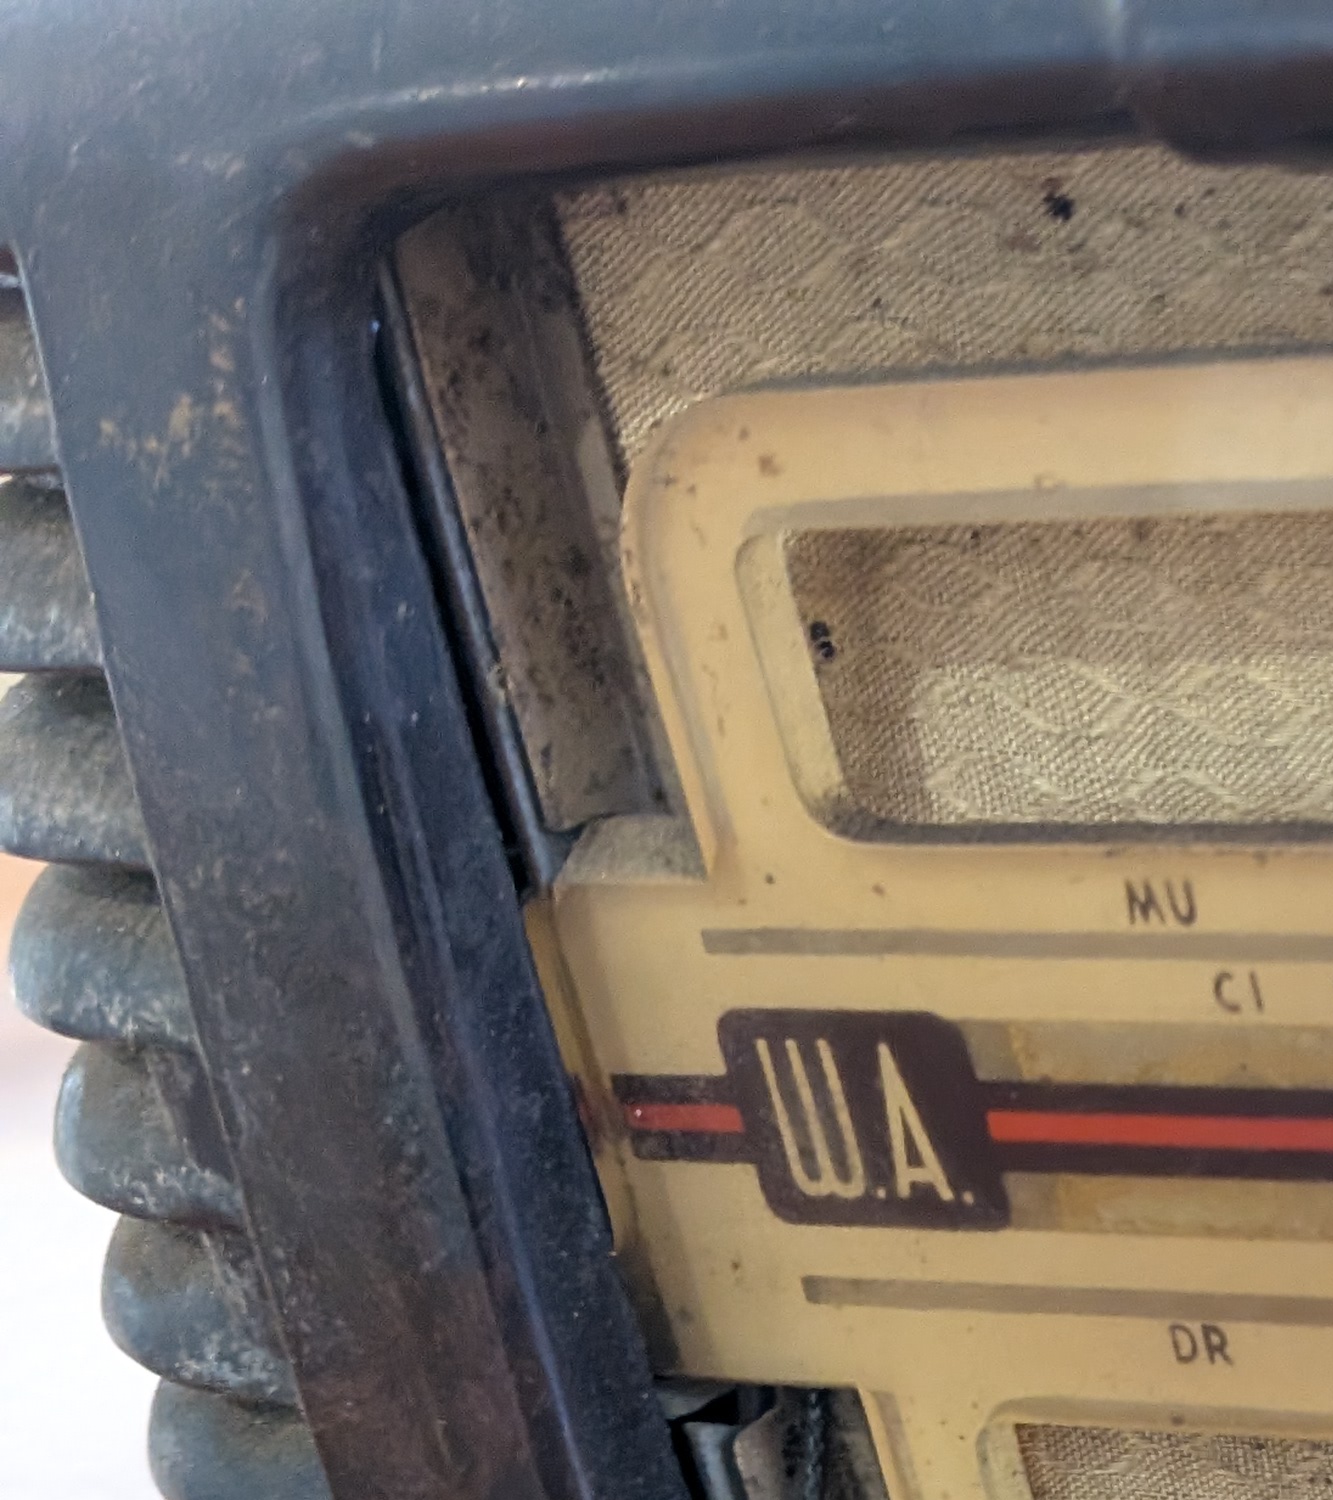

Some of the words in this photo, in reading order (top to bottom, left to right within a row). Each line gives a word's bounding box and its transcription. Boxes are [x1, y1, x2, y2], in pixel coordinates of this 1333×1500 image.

[1124, 879, 1197, 927] MU
[1212, 970, 1265, 1015] CI
[1168, 1321, 1233, 1365] DR
